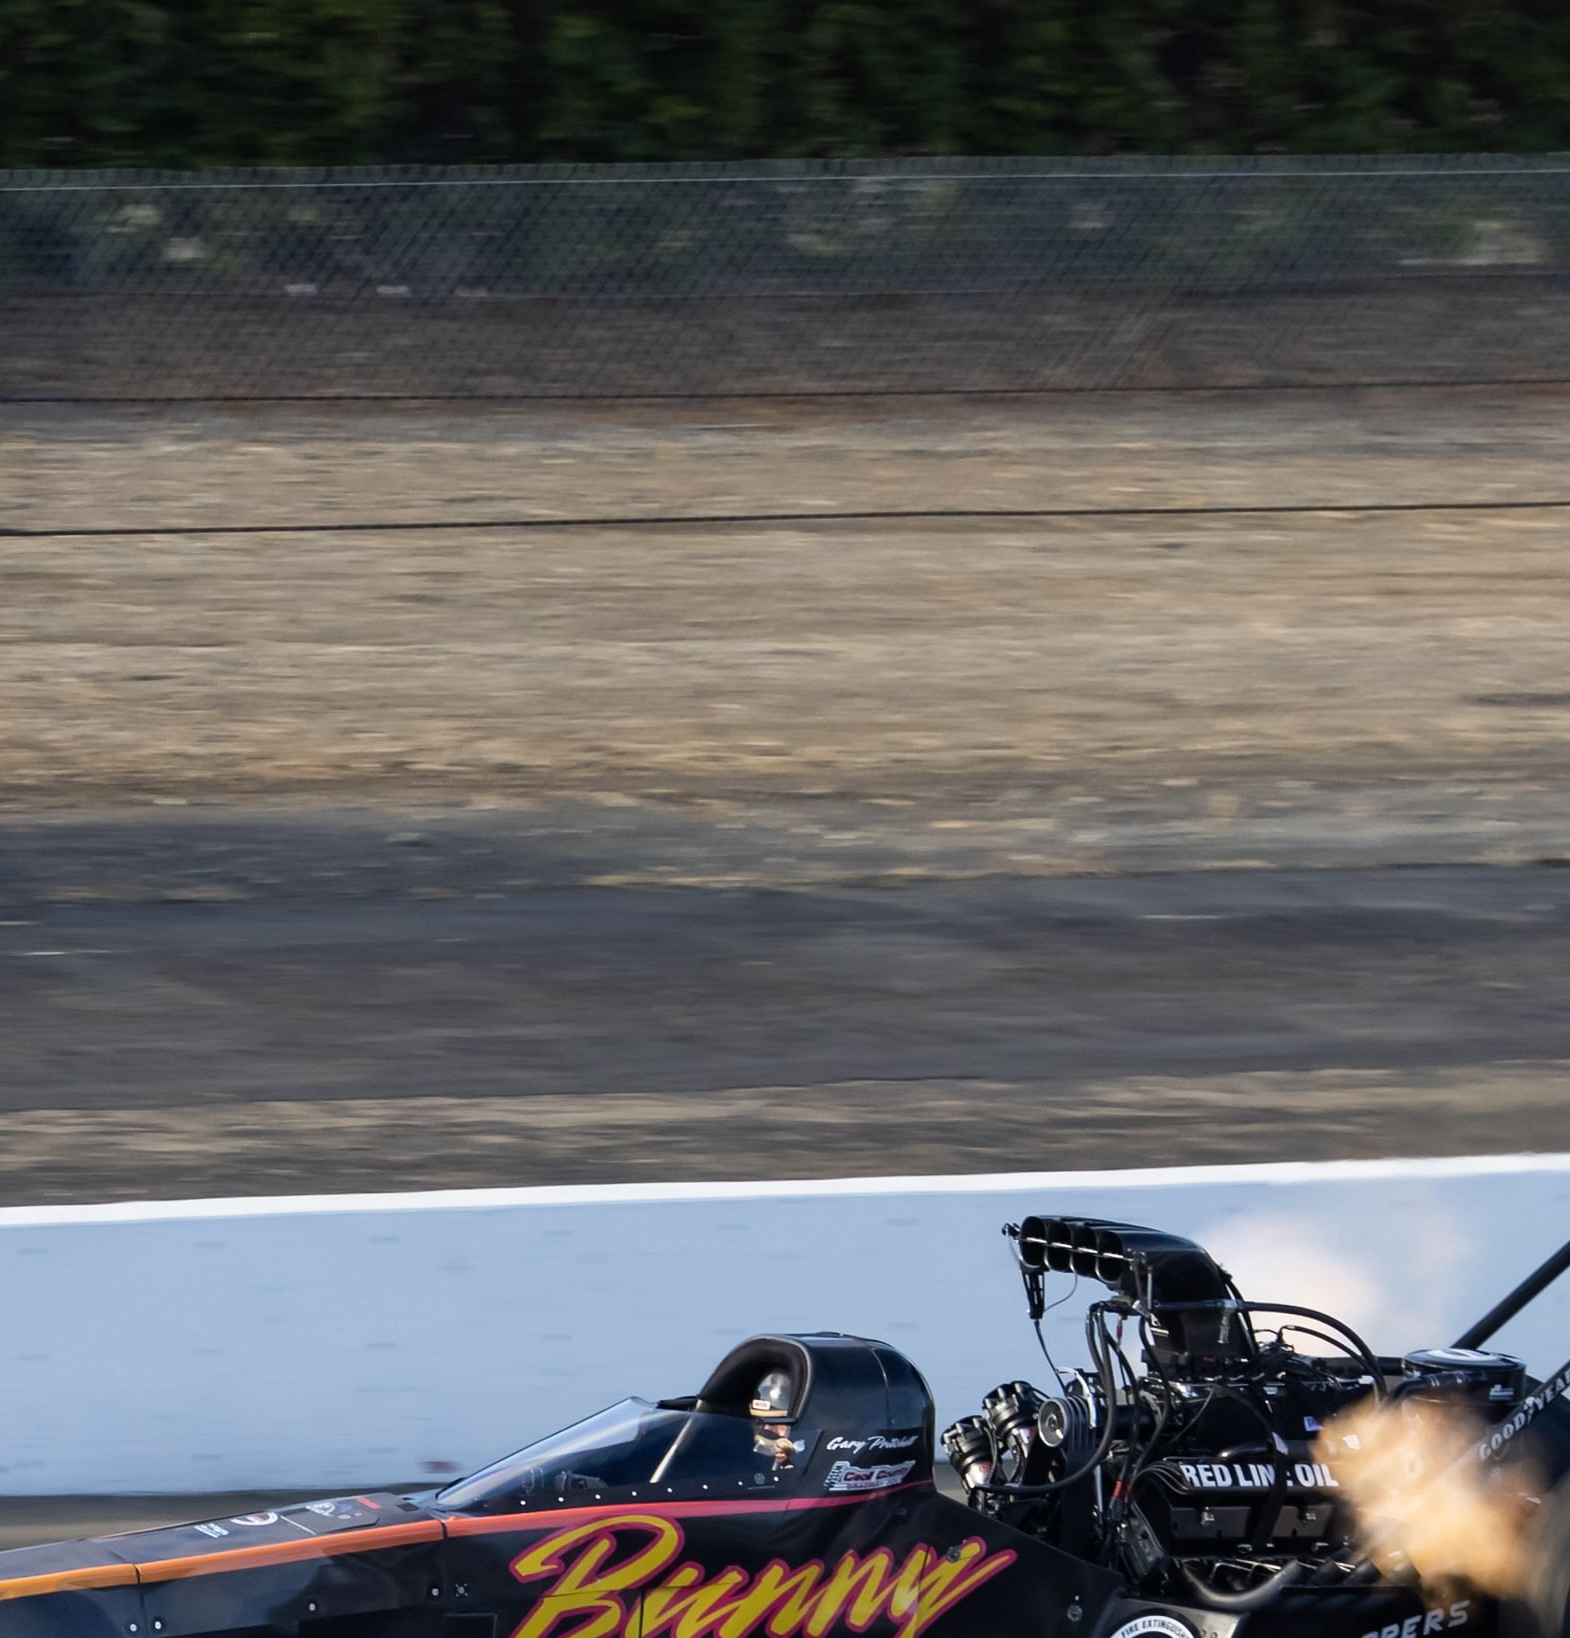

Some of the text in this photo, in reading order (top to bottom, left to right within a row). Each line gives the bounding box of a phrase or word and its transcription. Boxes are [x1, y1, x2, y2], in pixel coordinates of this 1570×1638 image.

[826, 1436, 866, 1454] Gary
[1180, 1464, 1233, 1487] RED
[1295, 1464, 1340, 1487] OIL
[1120, 1623, 1139, 1638] FIRE
